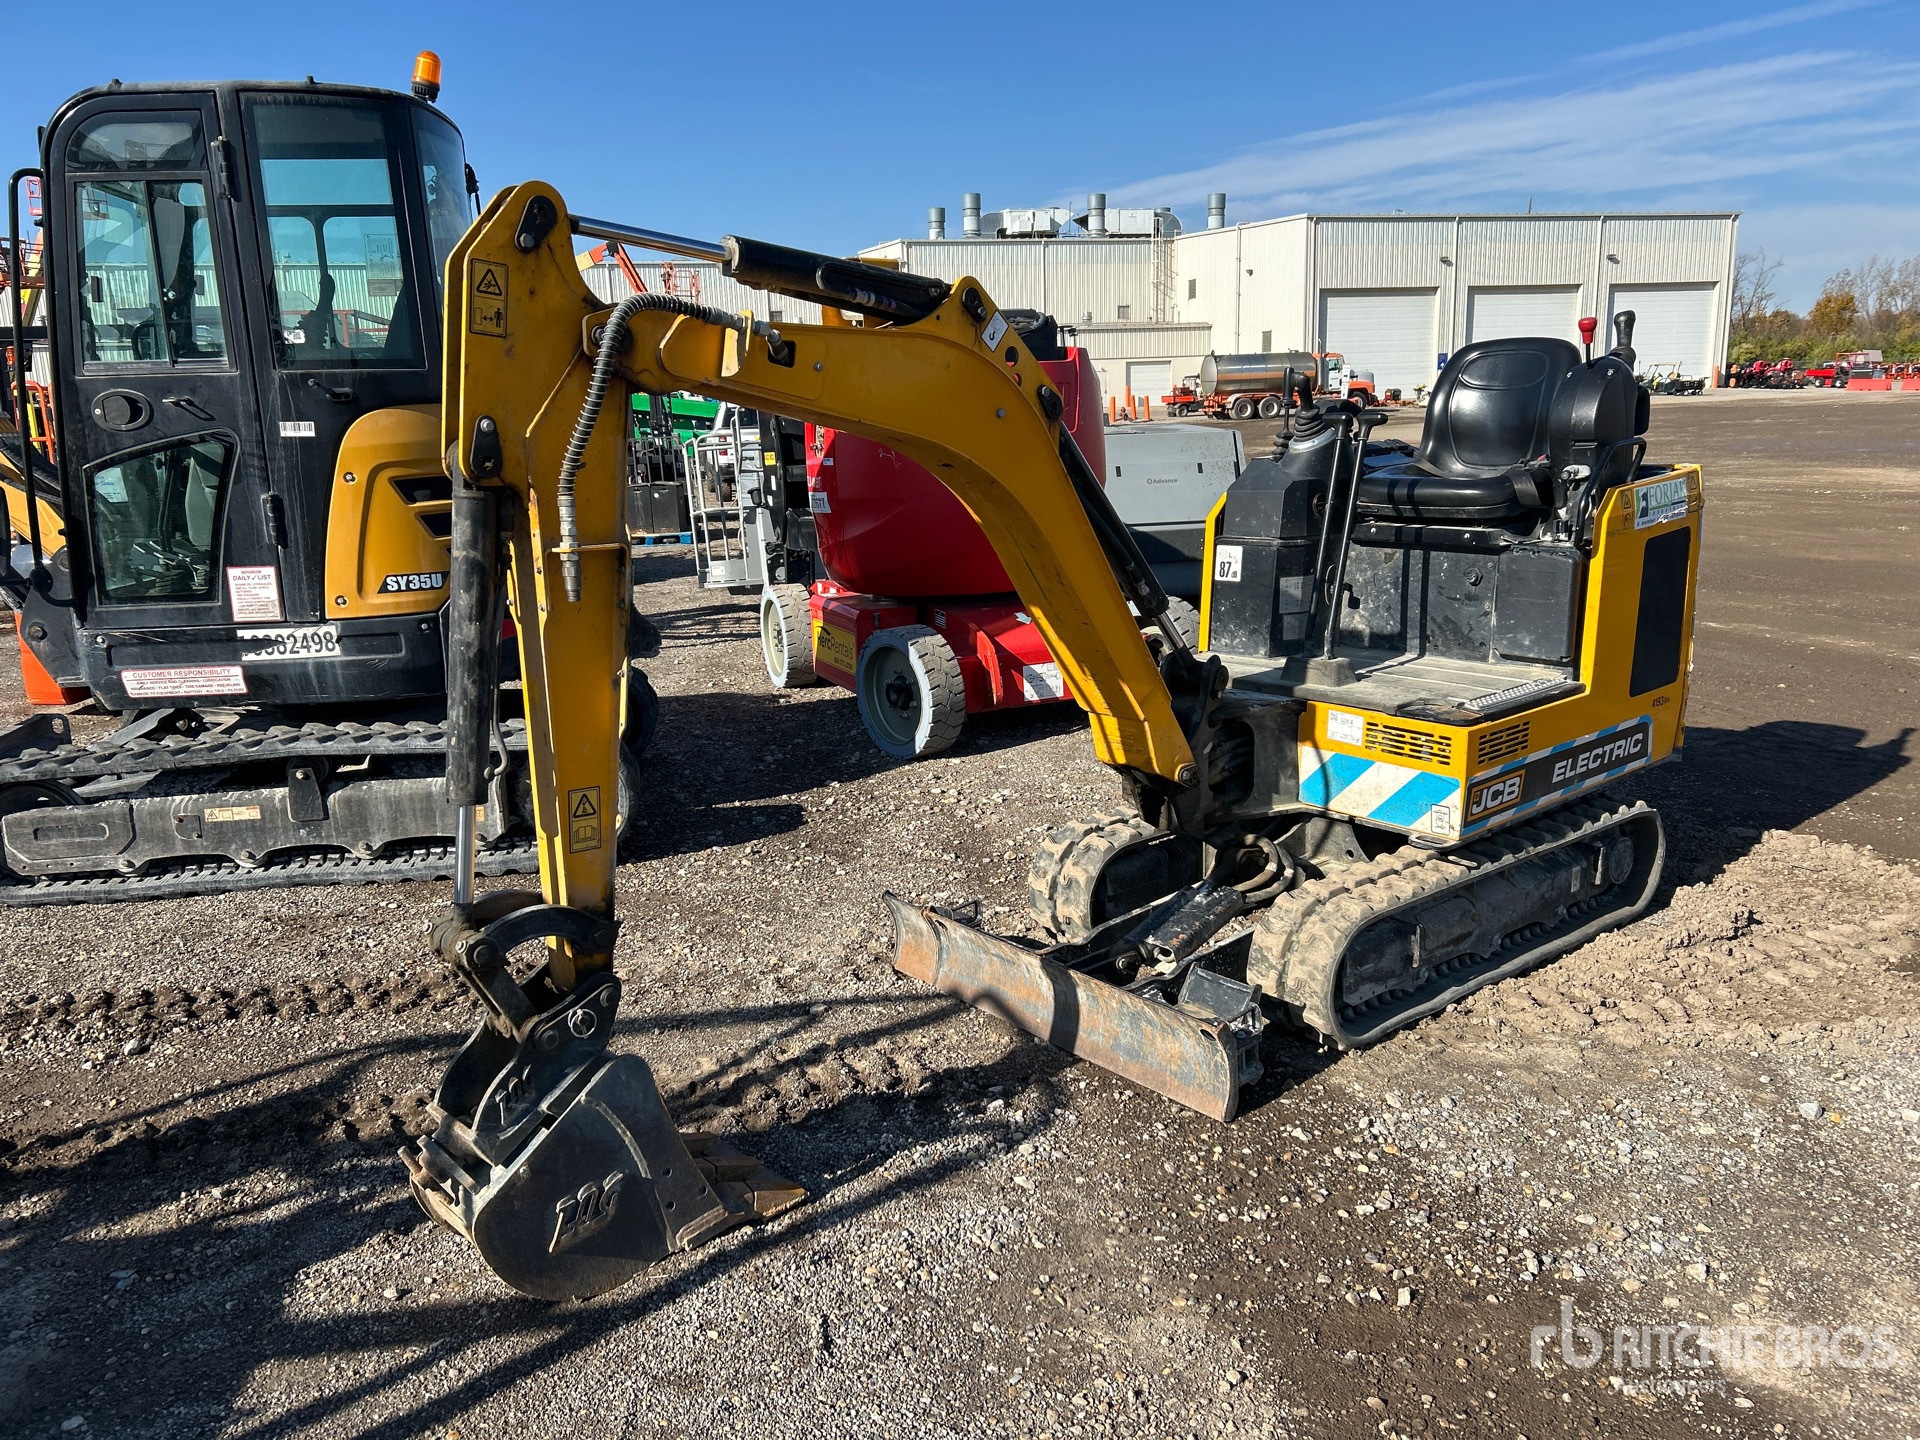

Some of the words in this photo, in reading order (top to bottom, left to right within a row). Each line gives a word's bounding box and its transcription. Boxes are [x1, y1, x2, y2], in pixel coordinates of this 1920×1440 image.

[1219, 561, 1231, 578] 87
[386, 573, 443, 591] SY35U
[132, 670, 172, 679] CUSTOMER
[173, 668, 231, 677] RESPONSIBILITY
[1552, 732, 1643, 784] ELECTRIC
[1471, 777, 1521, 814] JCB
